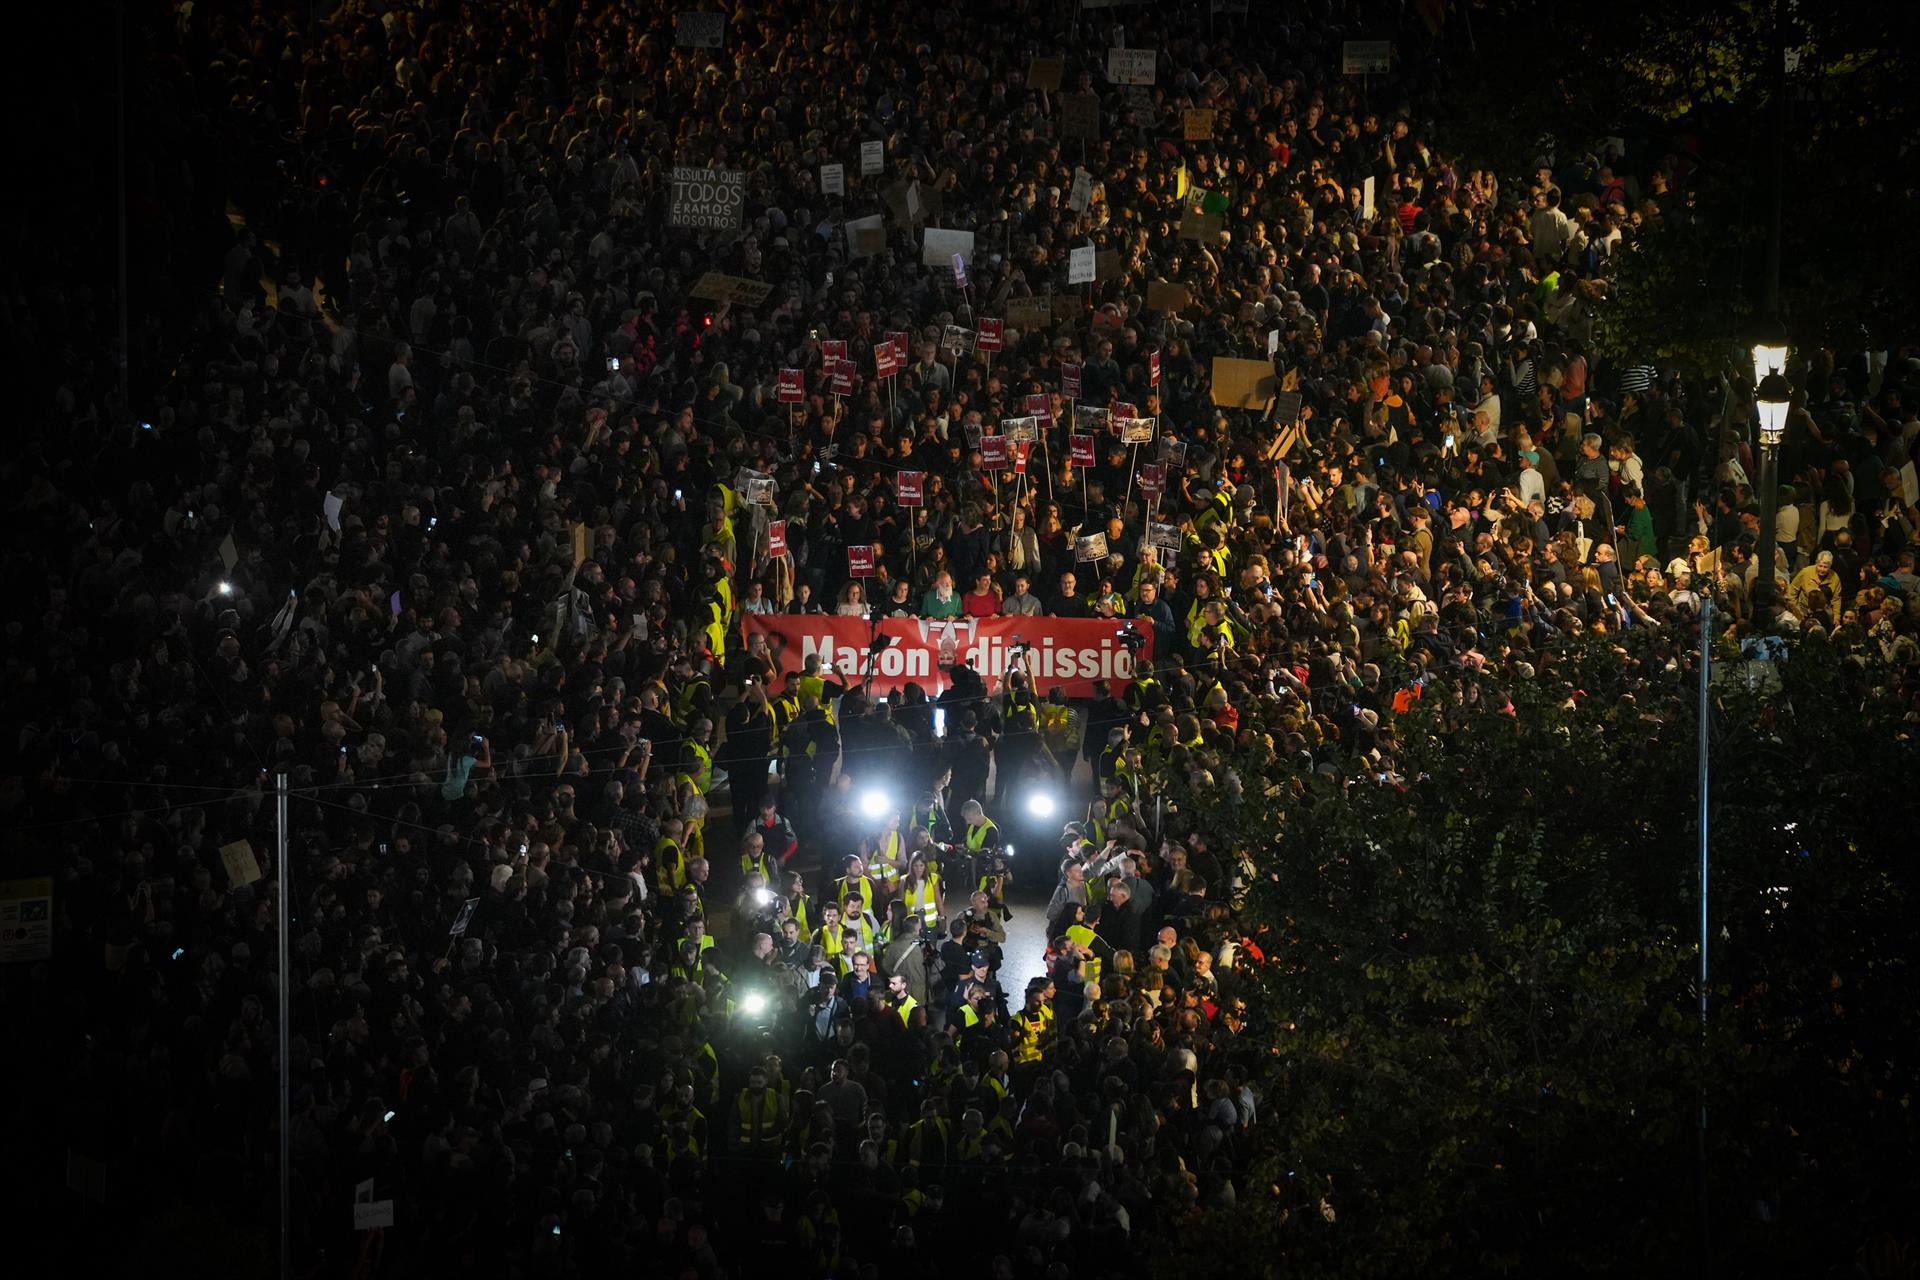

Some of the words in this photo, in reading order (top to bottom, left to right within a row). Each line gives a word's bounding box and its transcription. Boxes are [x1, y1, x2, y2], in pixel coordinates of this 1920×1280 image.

[673, 168, 716, 181] RESULTA
[720, 171, 743, 184] QUE
[674, 182, 742, 205] TODOS
[673, 200, 731, 215] ÉRAMOS
[673, 215, 736, 229] NOSOTROS
[802, 635, 930, 676] Mazón
